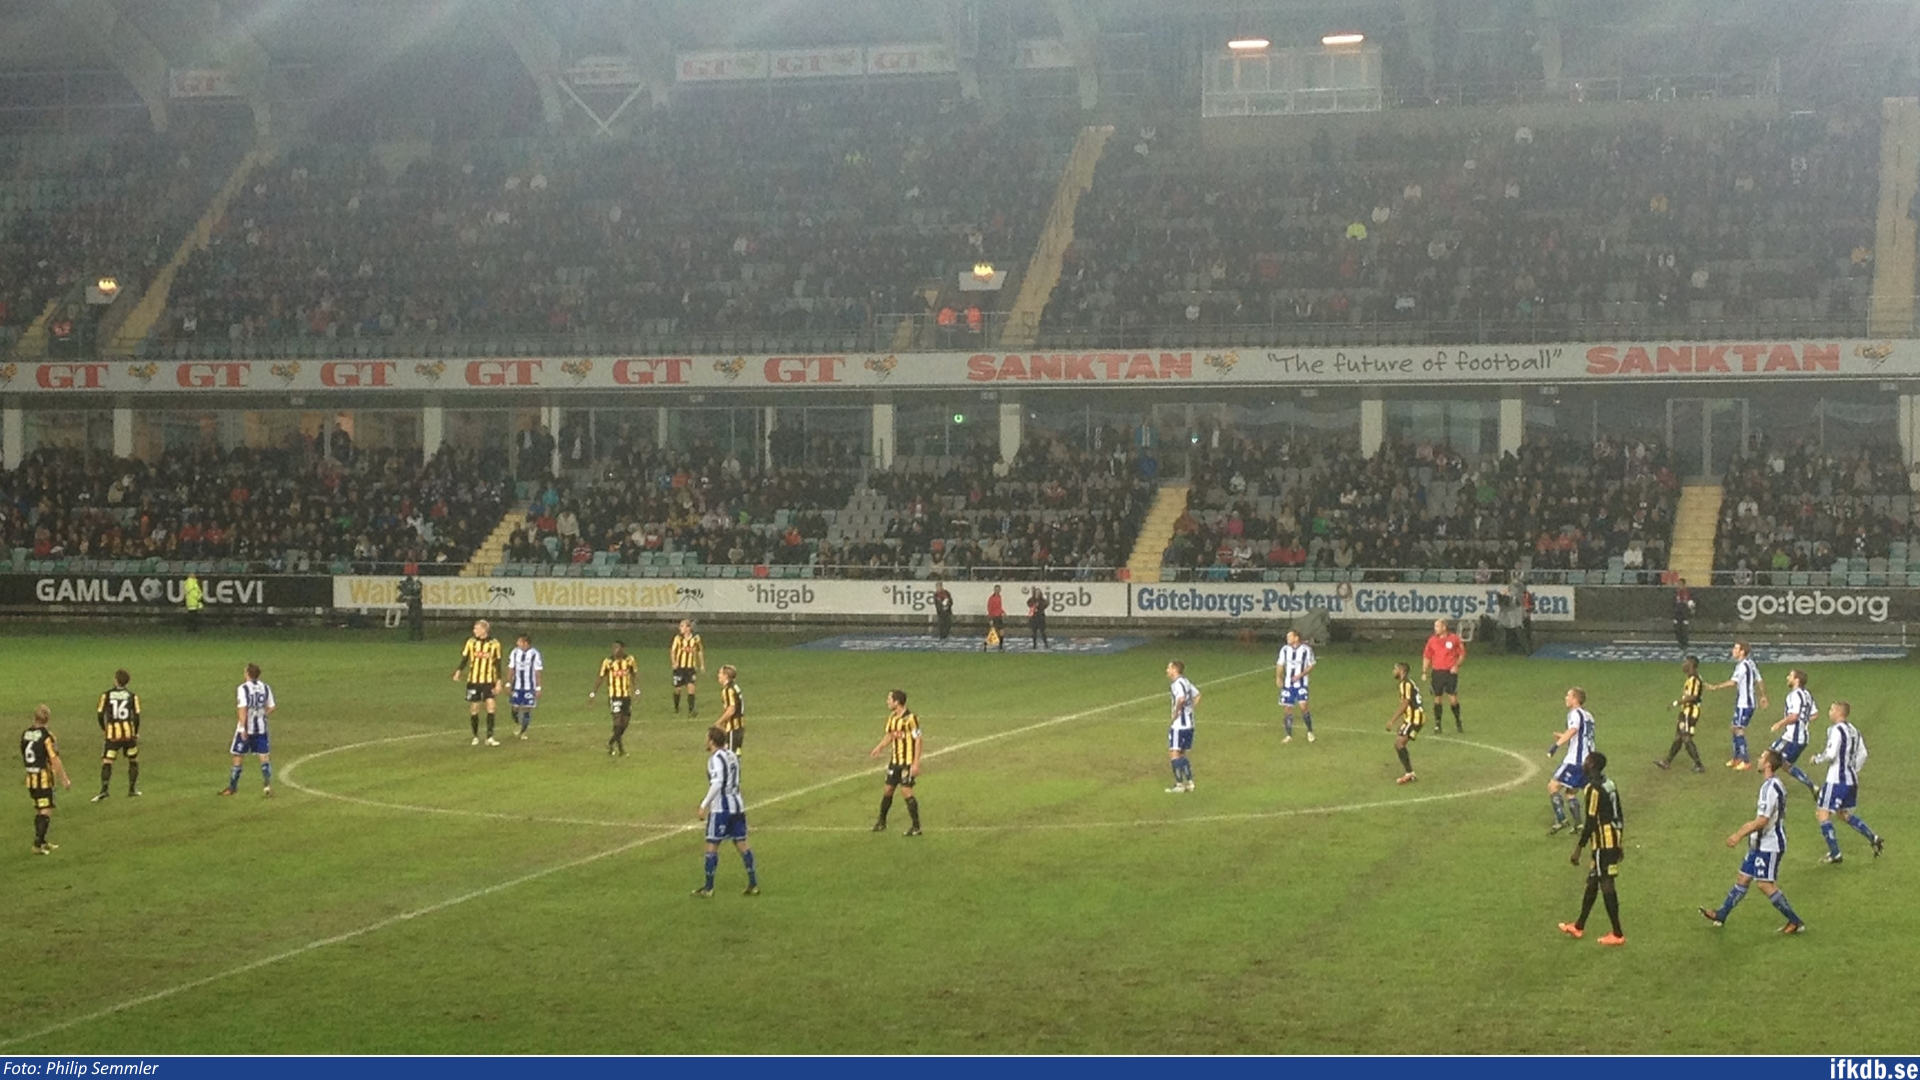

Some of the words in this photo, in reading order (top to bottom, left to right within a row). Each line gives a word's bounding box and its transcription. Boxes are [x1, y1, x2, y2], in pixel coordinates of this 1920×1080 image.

[612, 358, 693, 385] GT
[763, 356, 847, 383] GT
[966, 353, 1193, 381] SANKTAN
[1333, 350, 1414, 376] future
[1422, 350, 1447, 373] of
[1585, 345, 1841, 373] SANKTAN
[35, 363, 109, 390] GT
[176, 362, 251, 388] GT
[320, 361, 398, 387] GT
[464, 360, 543, 386] GT
[36, 578, 138, 602] GAMLA
[167, 580, 264, 603] ULEVI
[348, 579, 491, 607] Wallstam
[533, 580, 679, 608] Wallenstam
[757, 584, 815, 609] higab
[892, 585, 937, 609] higa
[1137, 586, 1343, 616] Göteborgs-Posten
[1355, 588, 1570, 618] Göteborgs-Pten
[110, 699, 130, 720] 16
[24, 741, 36, 764] 6
